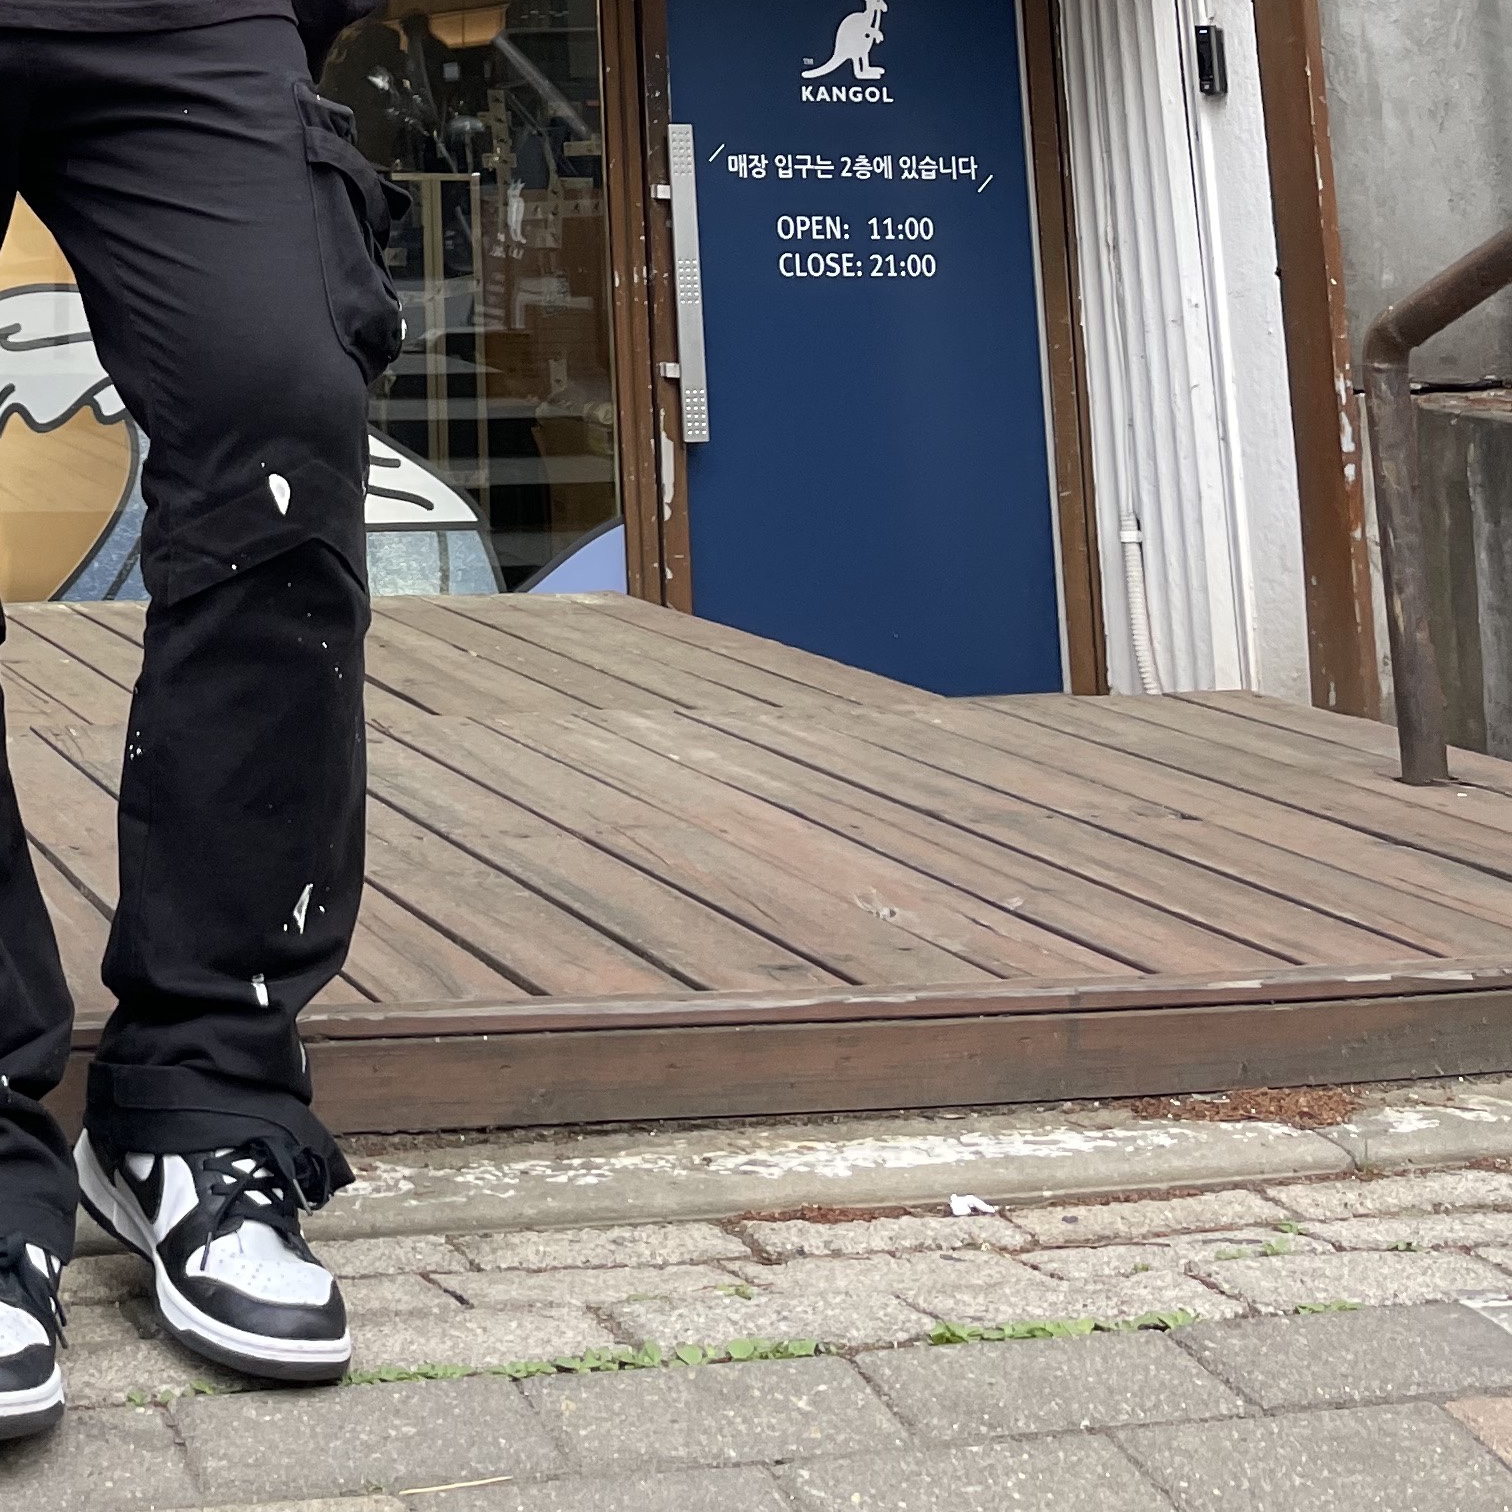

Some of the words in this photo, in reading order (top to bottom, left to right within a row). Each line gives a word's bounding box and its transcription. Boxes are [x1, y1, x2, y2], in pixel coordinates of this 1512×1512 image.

[801, 85, 894, 103] KANGOL
[726, 153, 769, 179] 매장
[773, 154, 836, 179] 입구는
[840, 154, 893, 180] 2층에
[898, 154, 978, 180] 있습니다
[776, 215, 850, 240] OPEN:
[867, 216, 934, 241] 11:00
[778, 252, 863, 277] CLOSE:
[869, 253, 937, 278] 21:00
